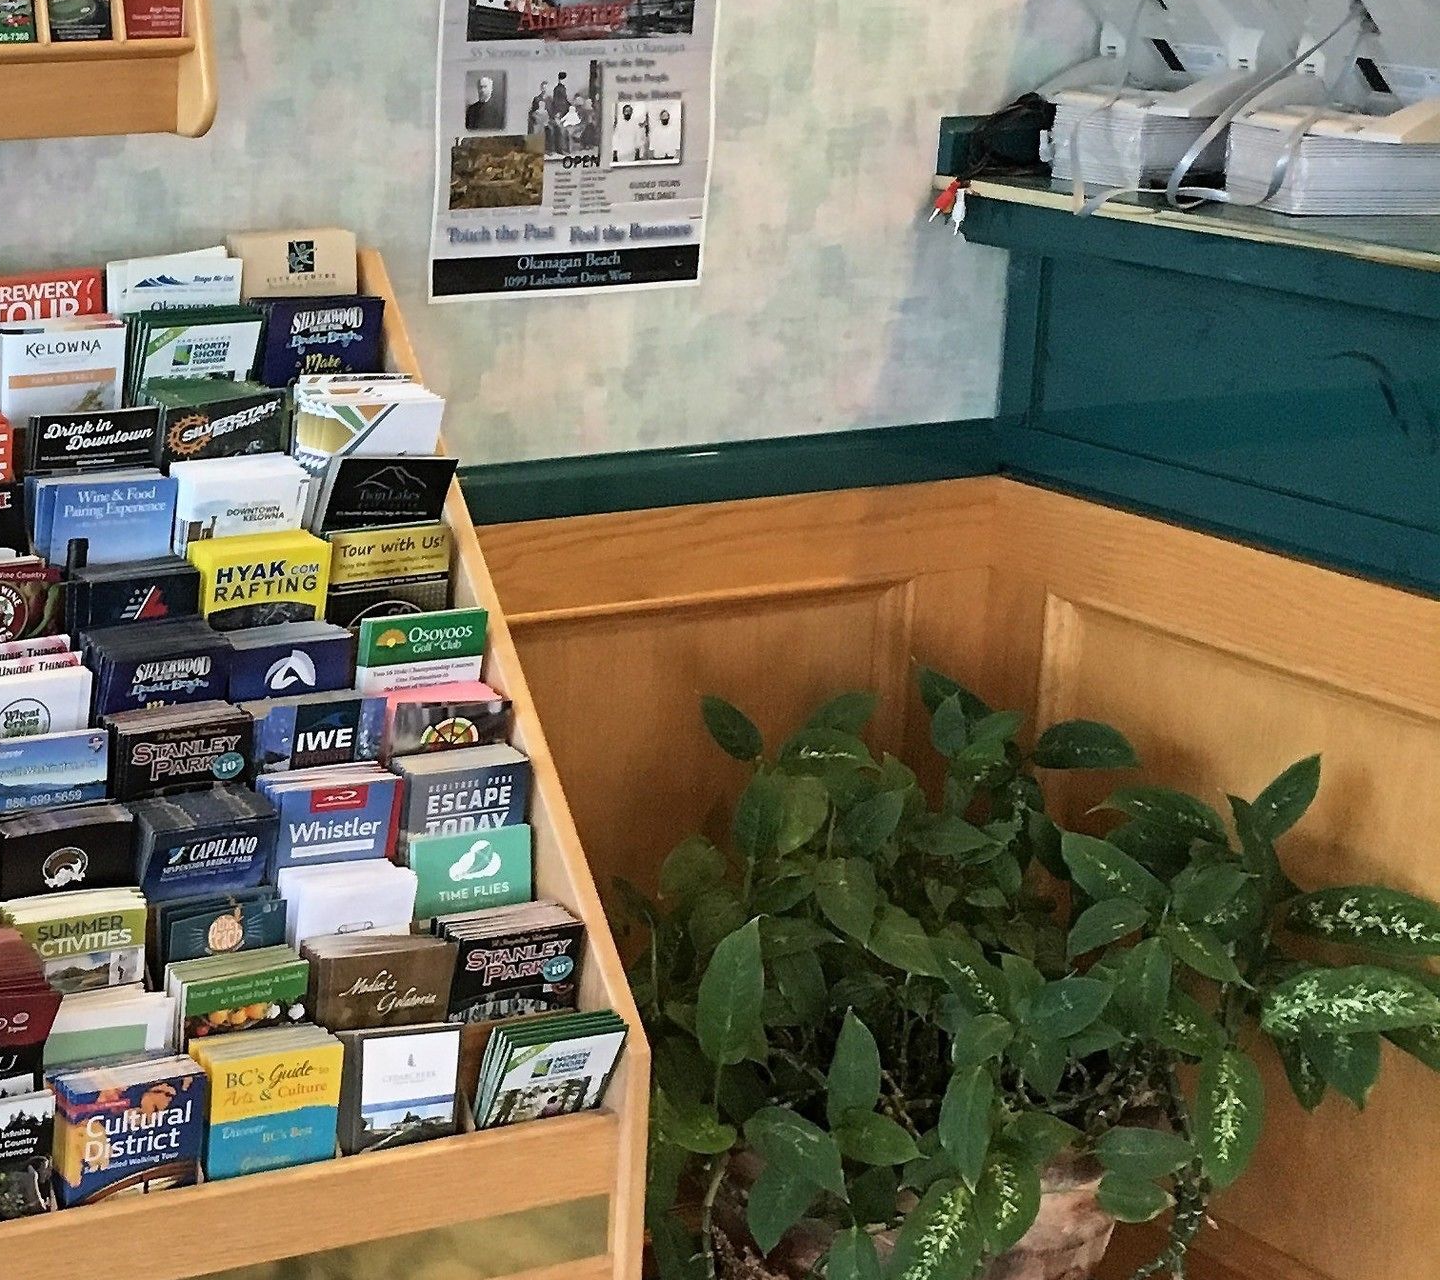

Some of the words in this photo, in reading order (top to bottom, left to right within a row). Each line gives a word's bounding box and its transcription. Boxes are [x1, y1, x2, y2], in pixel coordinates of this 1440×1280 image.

[563, 155, 601, 169] OPEN
[517, 254, 582, 272] Okanagan
[586, 251, 621, 266] Beach
[503, 275, 527, 288] 1099
[580, 270, 606, 285] Drive
[192, 340, 230, 352] NORTH
[192, 349, 229, 360] SHORE
[307, 352, 341, 373] Make
[43, 421, 89, 440] Drink
[91, 418, 114, 434] in
[65, 426, 154, 452] Downtown
[78, 490, 110, 504] Wine
[112, 490, 123, 501] &
[126, 485, 157, 499] Food
[64, 504, 105, 521] Pairing
[106, 499, 168, 516] Experience
[226, 504, 280, 518] DOWNTOWN
[340, 543, 377, 559] Tour
[381, 537, 416, 553] with
[422, 534, 446, 550] Us!
[16, 570, 47, 582] Country
[216, 560, 287, 585] HYAK
[1, 585, 24, 607] WINE
[213, 575, 318, 603] RAFTING
[408, 625, 474, 645] Osoyoos
[412, 642, 433, 654] Golf
[440, 639, 463, 652] Club
[4, 708, 40, 721] Wheat
[131, 734, 242, 766] STANLEY
[296, 727, 354, 753] IWE
[150, 754, 217, 782] PARK
[426, 785, 512, 815] ESCAPE
[288, 816, 382, 844] Whistler
[425, 812, 508, 836] TODAY
[189, 836, 258, 862] CAPILANO
[438, 887, 469, 902] TIME
[473, 881, 510, 898] FLIES
[37, 914, 124, 941] SUMMER
[465, 938, 573, 972] STANLEY
[224, 1067, 265, 1090] BC's
[268, 1058, 313, 1086] Guide
[259, 1087, 273, 1102] &
[276, 1080, 328, 1099] Culture
[84, 1099, 194, 1138] Cultural
[4, 1135, 39, 1151] Country
[81, 1127, 181, 1164] District
